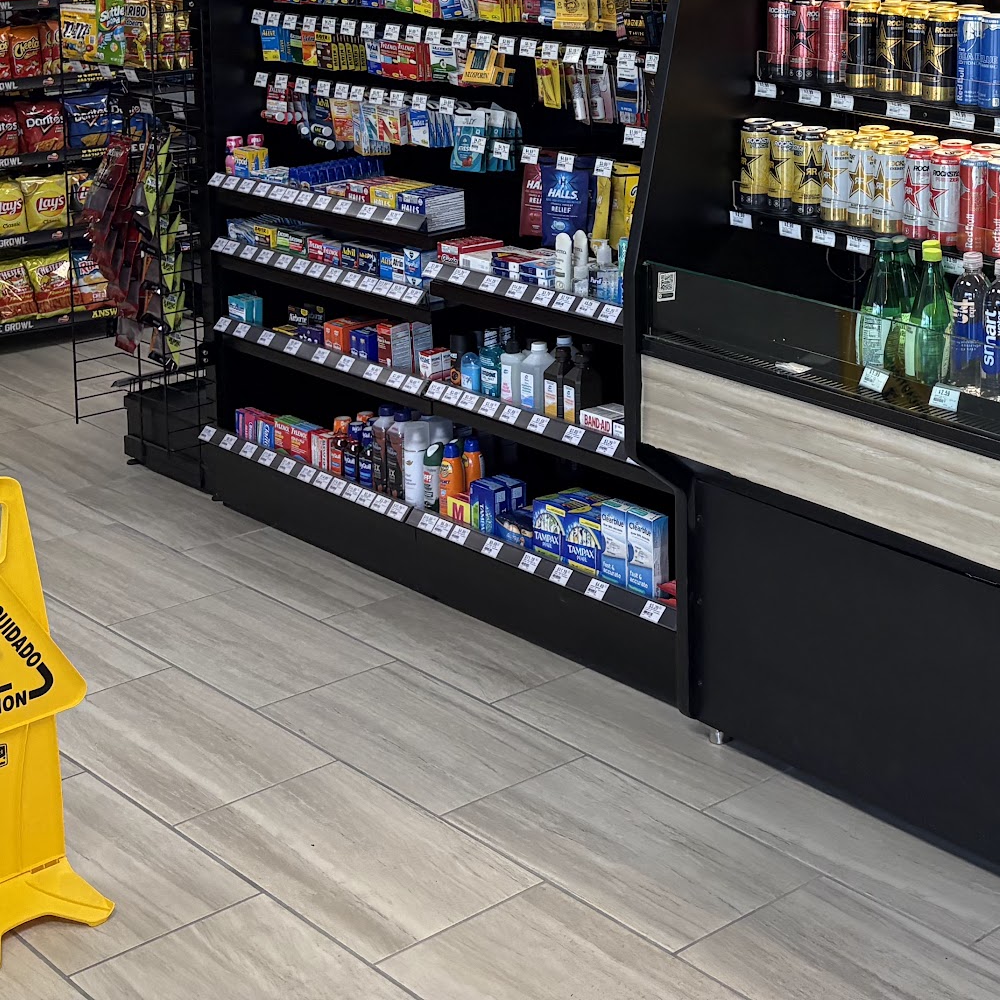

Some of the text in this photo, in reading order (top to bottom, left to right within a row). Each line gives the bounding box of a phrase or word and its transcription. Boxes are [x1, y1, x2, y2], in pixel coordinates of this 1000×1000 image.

[548, 188, 578, 200] HALLS
[38, 196, 64, 212] Lay's
[551, 204, 571, 214] RELIEF
[4, 321, 34, 332] GROWL
[984, 308, 997, 366] smart
[584, 414, 612, 432] BAND-AID
[602, 513, 624, 528] Clearblue
[628, 522, 652, 537] Clearblue
[534, 531, 559, 546] TAMPAX
[567, 544, 595, 559] TAMPAX
